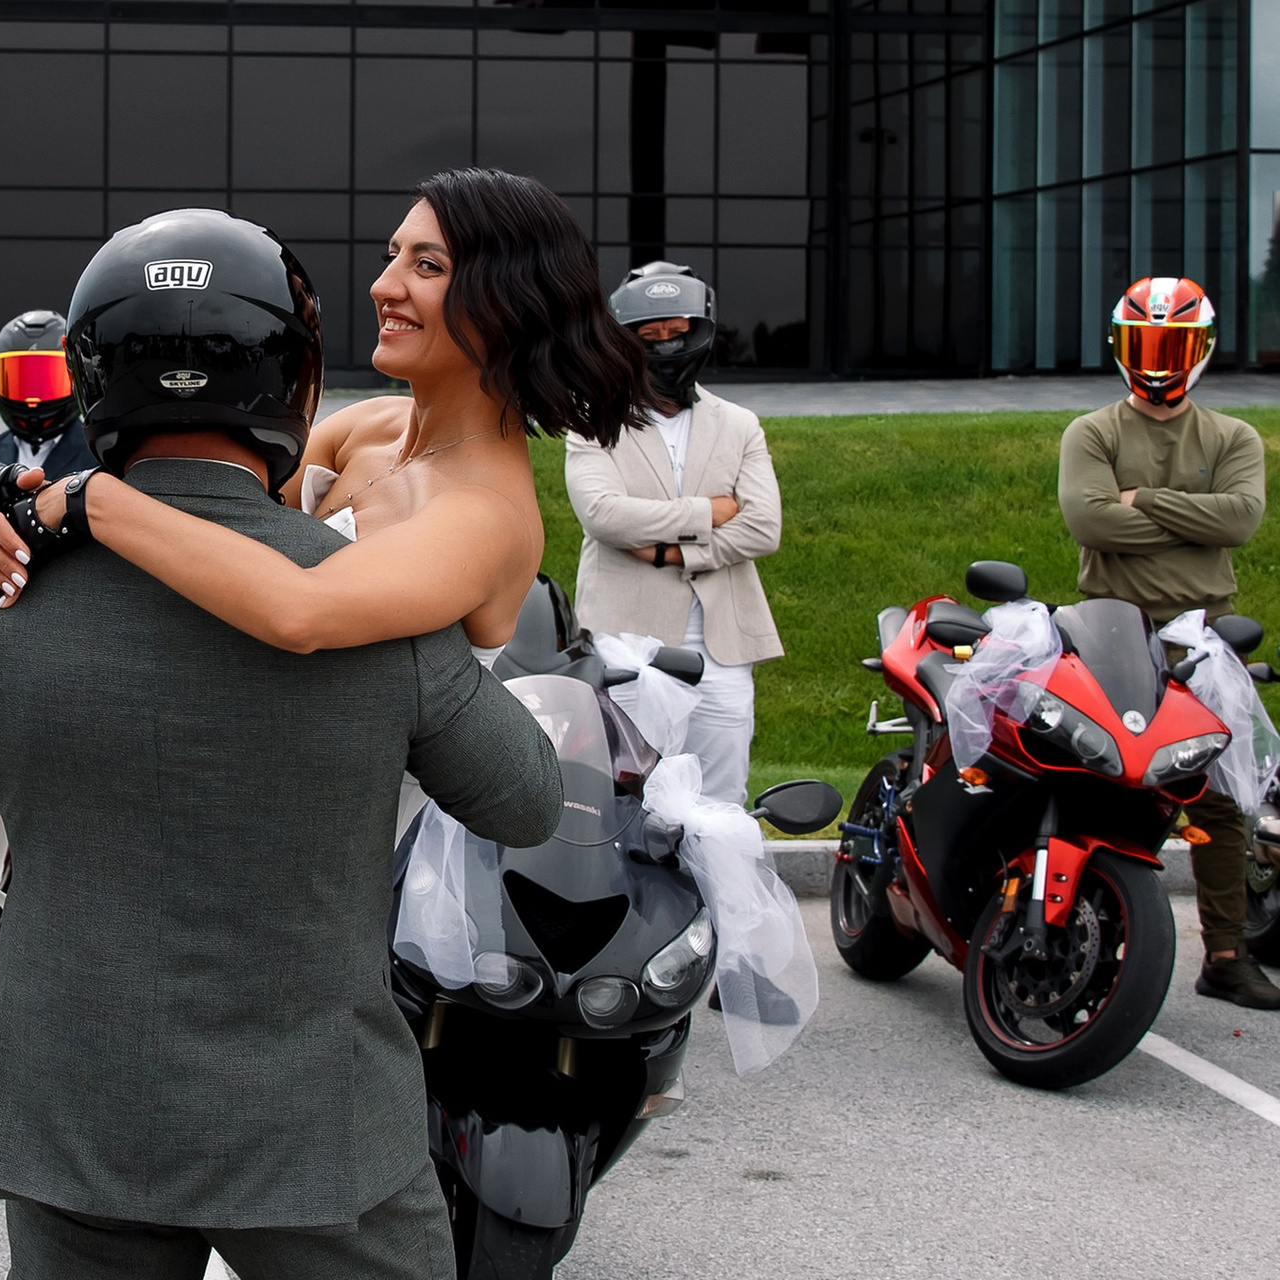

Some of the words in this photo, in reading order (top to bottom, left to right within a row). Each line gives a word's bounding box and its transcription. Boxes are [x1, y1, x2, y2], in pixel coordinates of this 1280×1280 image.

[154, 265, 203, 287] agv
[1150, 304, 1170, 312] agv
[564, 800, 601, 817] wasaki
